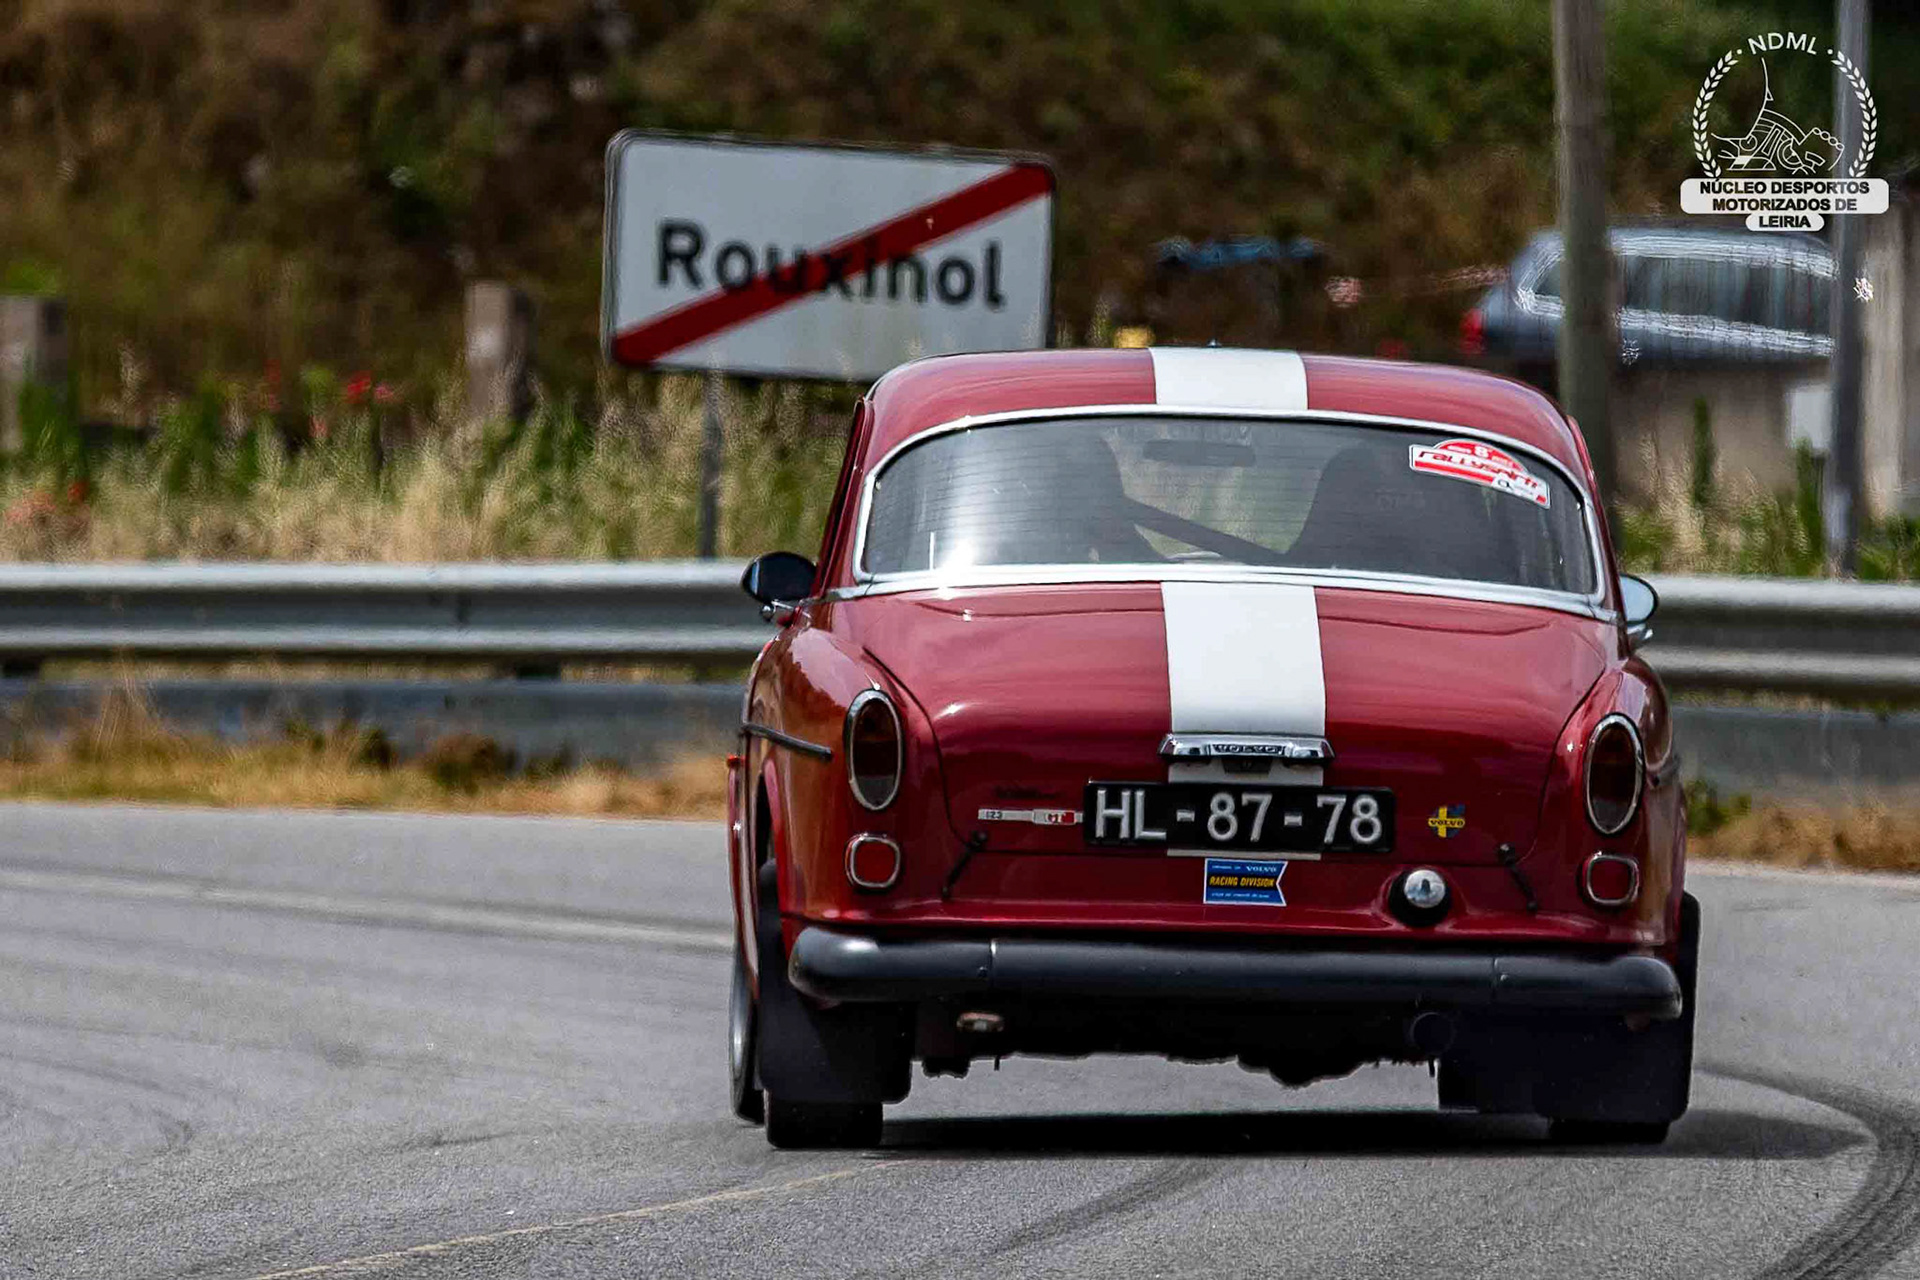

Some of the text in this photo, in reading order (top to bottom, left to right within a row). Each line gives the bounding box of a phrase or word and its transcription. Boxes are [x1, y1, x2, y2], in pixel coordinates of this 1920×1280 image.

[657, 217, 1006, 312] Rouxinol
[1209, 876, 1275, 887] RACING DIVISION
